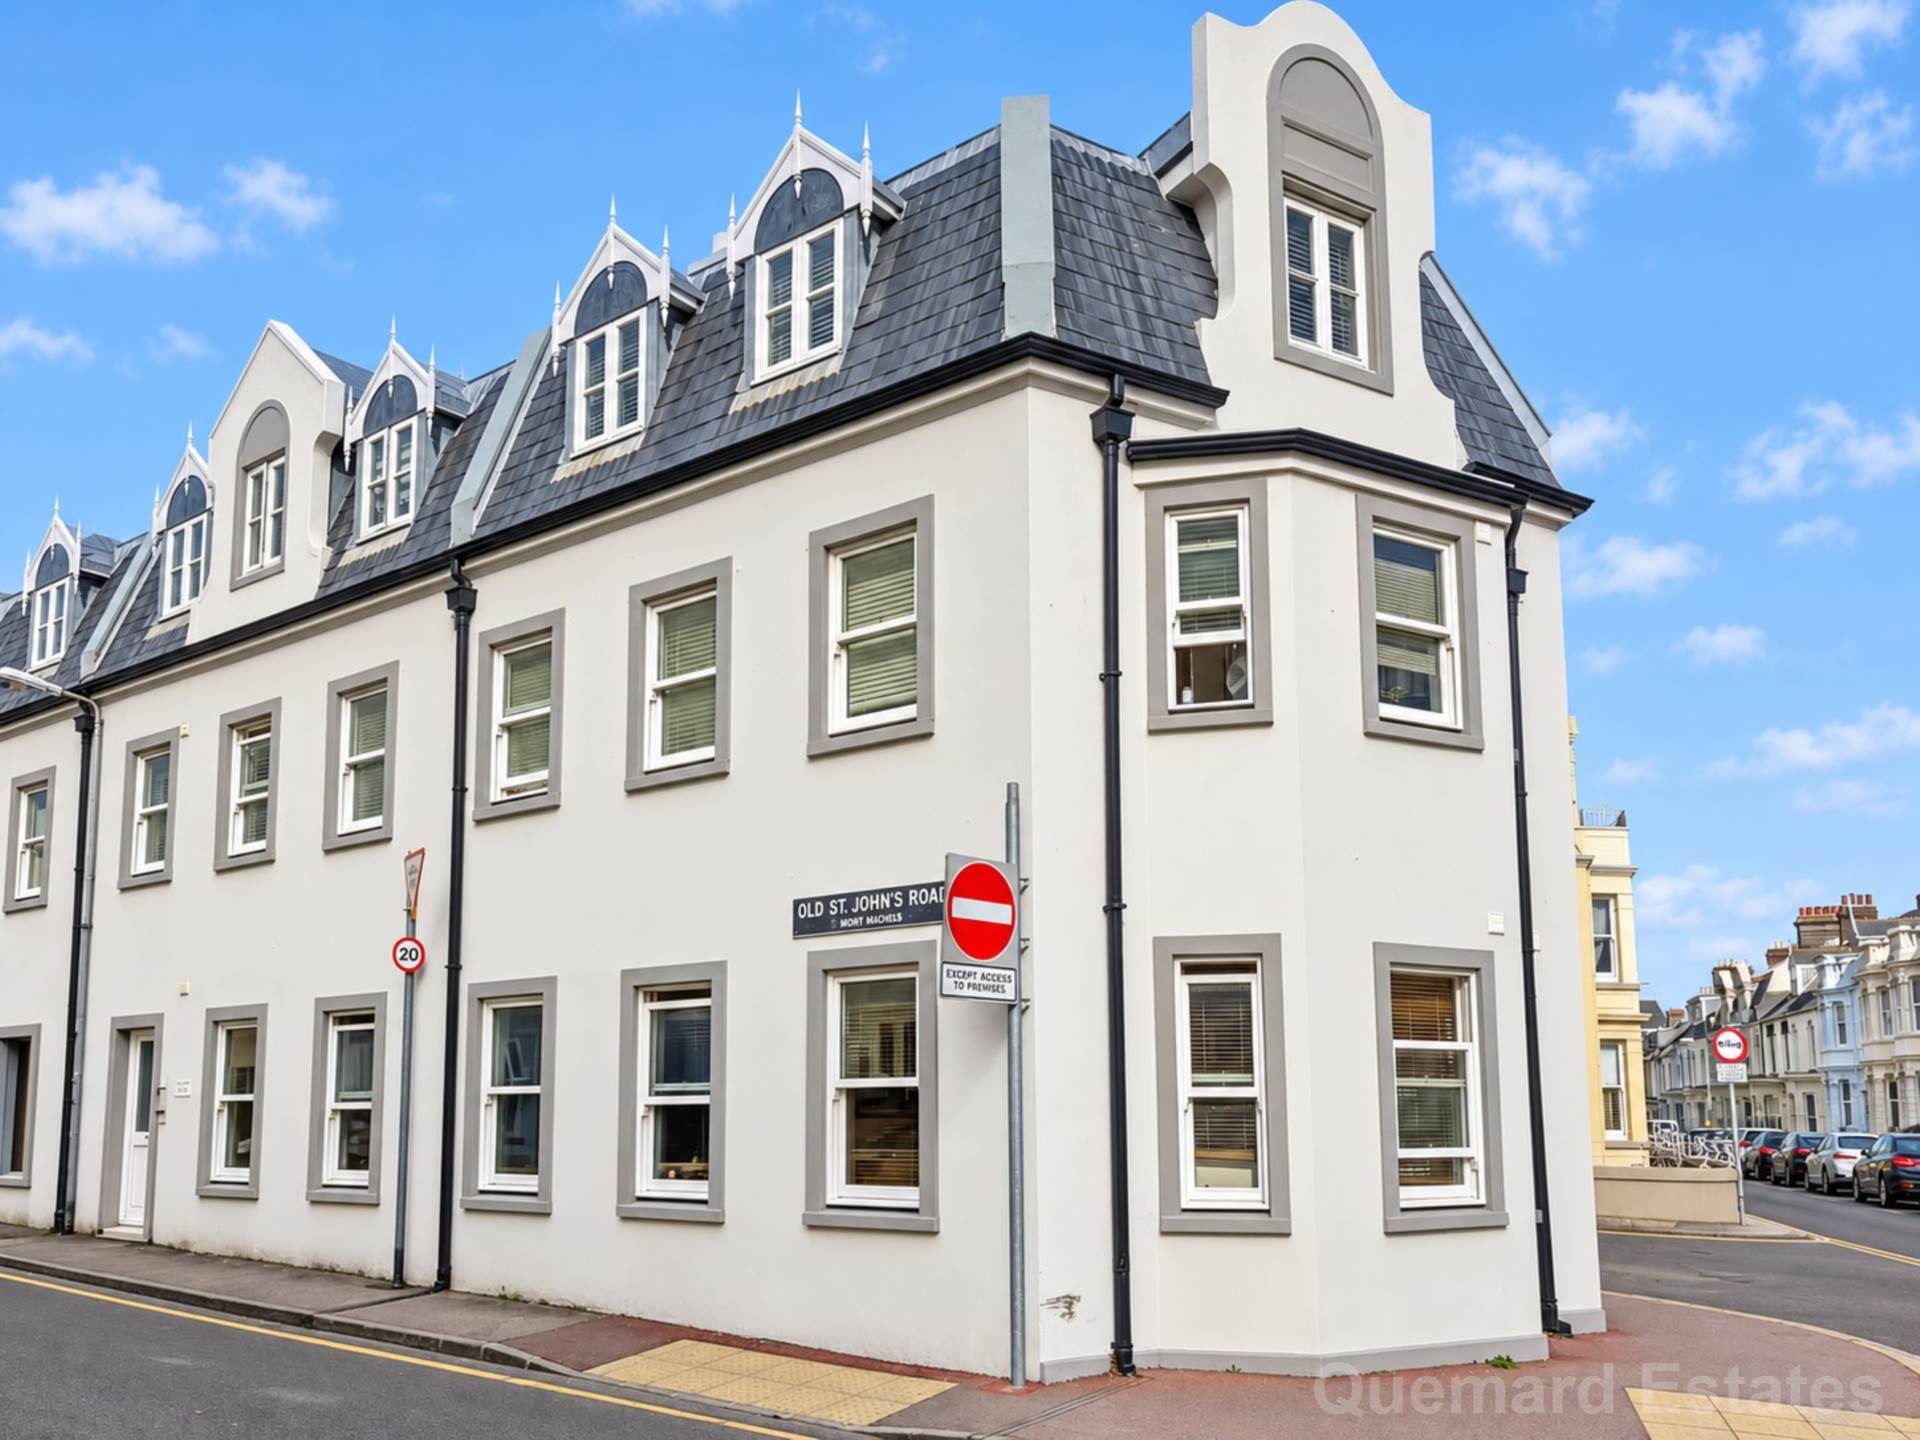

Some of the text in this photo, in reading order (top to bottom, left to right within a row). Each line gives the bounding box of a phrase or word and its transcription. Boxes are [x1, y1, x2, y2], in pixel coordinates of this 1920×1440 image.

[798, 901, 824, 919] OLD
[829, 898, 848, 916] ST.
[851, 891, 903, 913] JOHN'S
[399, 947, 419, 961] 20
[946, 969, 1012, 984] EXCEPT ACCESS
[953, 981, 1006, 994] TO PREMISES
